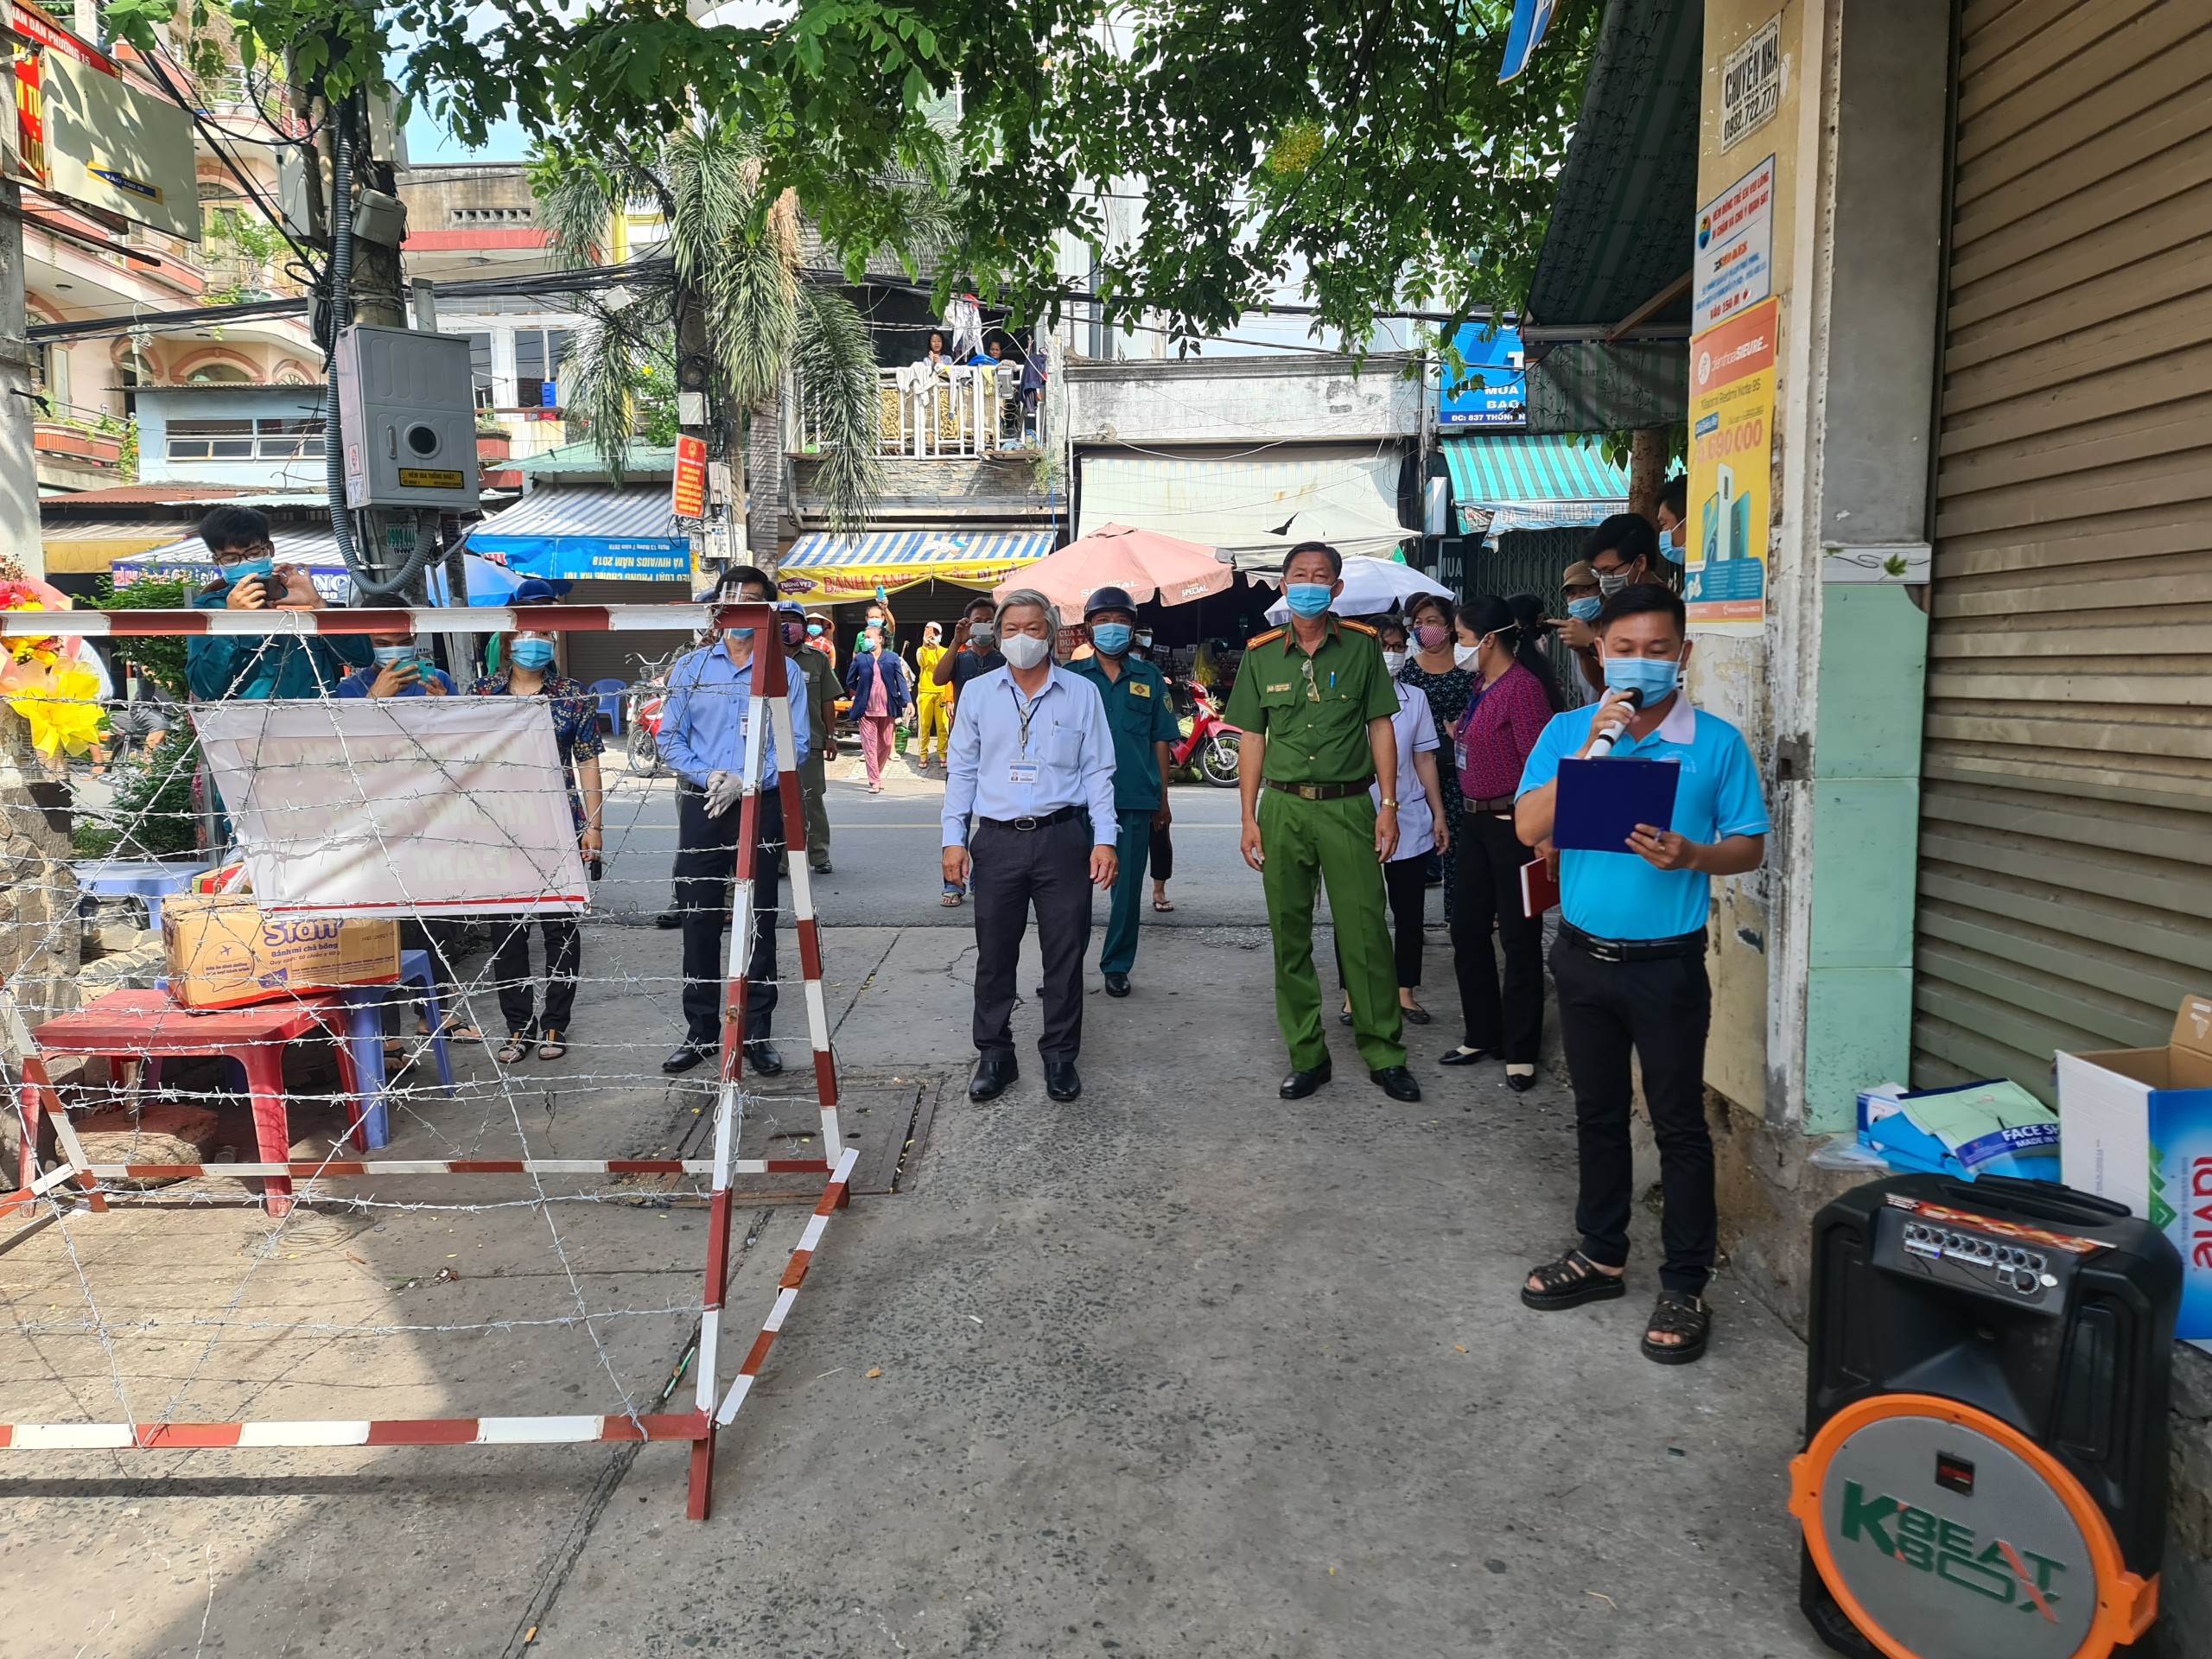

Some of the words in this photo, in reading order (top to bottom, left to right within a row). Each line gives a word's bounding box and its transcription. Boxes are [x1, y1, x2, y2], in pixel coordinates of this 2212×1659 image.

[29, 20, 47, 39] DÂN
[48, 30, 79, 60] PHƯỜNG
[81, 53, 91, 66] 15
[592, 556, 613, 566] 2018
[636, 556, 671, 568] HIV/AIDS
[1181, 584, 1209, 597] SPECIAL
[271, 949, 291, 957] Bánh
[2001, 1124, 2042, 1141] FACE
[2015, 1136, 2044, 1147] MADE
